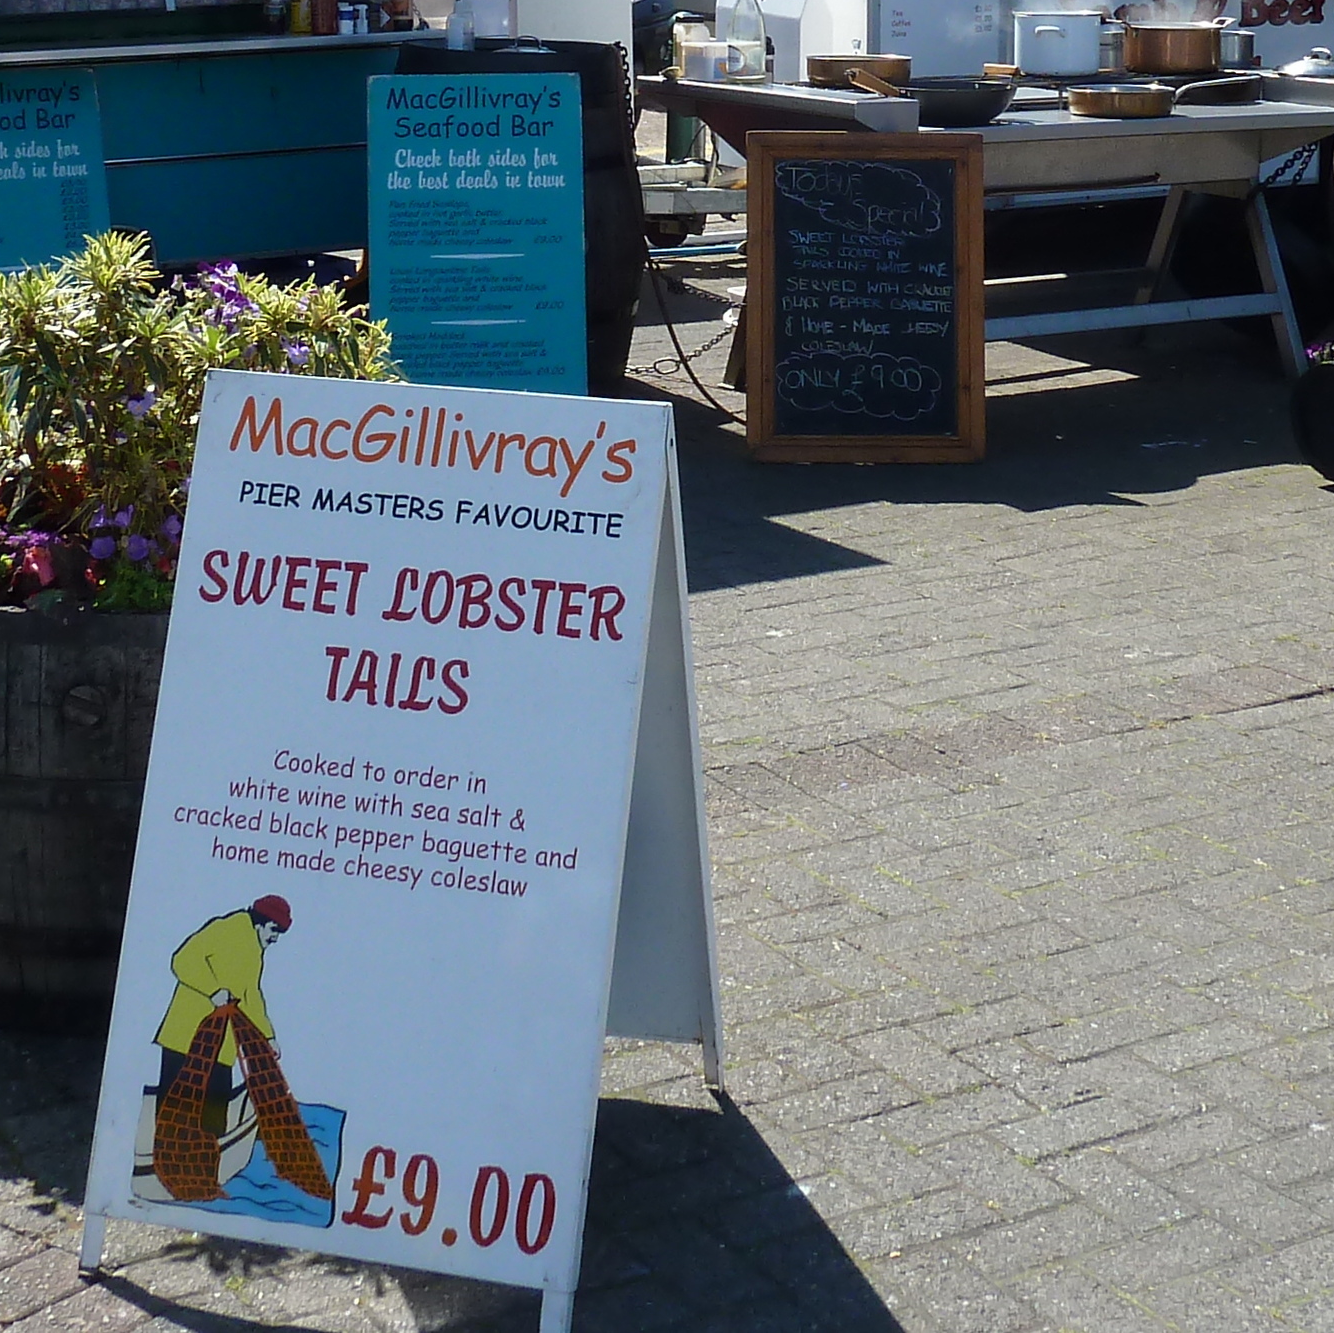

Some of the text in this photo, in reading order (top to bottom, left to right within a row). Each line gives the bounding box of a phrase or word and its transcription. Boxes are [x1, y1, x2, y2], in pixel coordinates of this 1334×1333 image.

[386, 85, 561, 114] MacGillivray's
[36, 108, 76, 130] Bar
[394, 115, 554, 139] Seafood Bar
[14, 140, 51, 159] sides
[57, 139, 80, 158] for
[395, 147, 559, 170] Check both sides for
[32, 163, 47, 178] in
[53, 161, 88, 177] town
[387, 170, 567, 190] the best deals in town
[788, 230, 836, 244] SWEET
[888, 248, 901, 260] IN
[918, 262, 948, 277] WINE
[786, 277, 856, 293] SERVED
[868, 281, 899, 294] WITH
[829, 296, 884, 311] PEPPER
[785, 367, 841, 389] ONLY
[229, 395, 637, 498] MacGillivray's
[240, 480, 624, 539] PIER MASTERS FAVOURITE
[198, 549, 626, 642] SWEET LOBSTER
[325, 646, 471, 715] TAILS
[273, 749, 487, 795] Cooked to order in
[229, 776, 526, 832] white wine with sea salt &
[173, 803, 579, 871] cracked black pepper baguette and
[212, 836, 529, 899] home made cheesy coleslaw
[341, 1144, 557, 1256] £9.00
